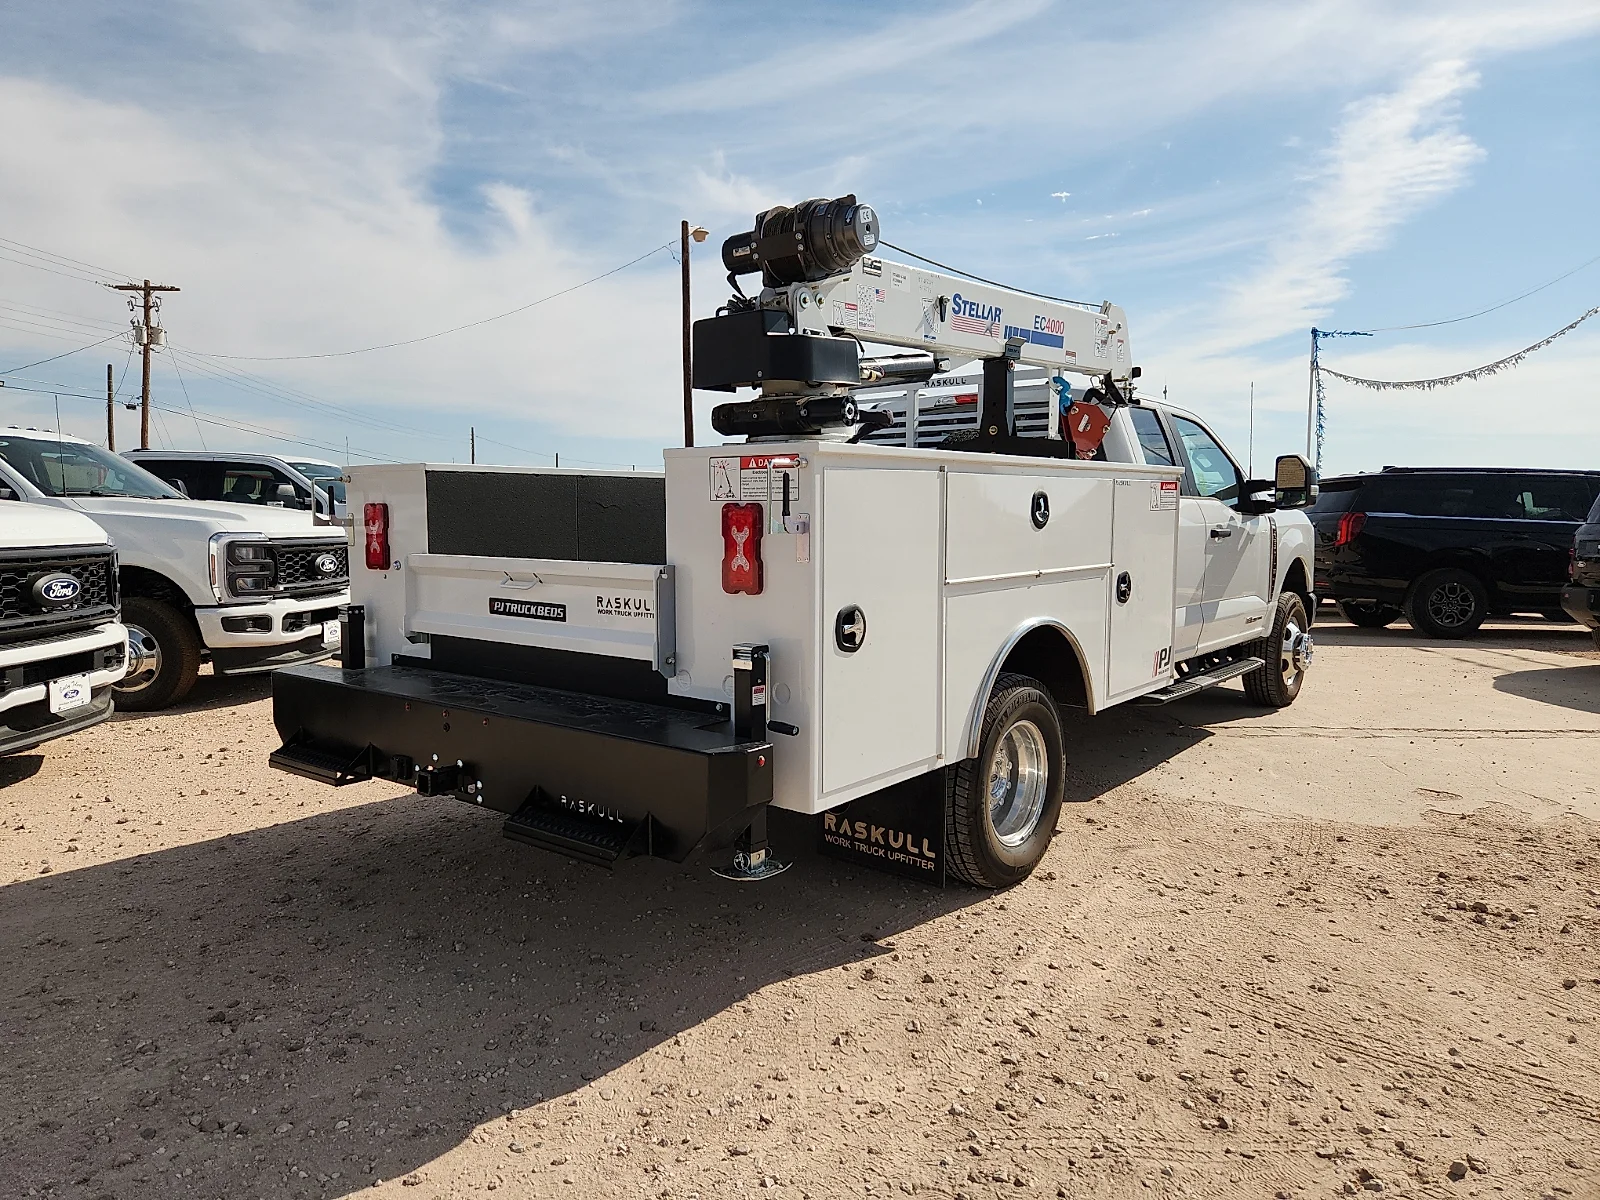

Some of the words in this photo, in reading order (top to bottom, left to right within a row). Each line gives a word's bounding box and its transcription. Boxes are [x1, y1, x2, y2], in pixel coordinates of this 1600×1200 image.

[952, 293, 1002, 323] STELLAR
[1034, 314, 1065, 335] EC4000
[48, 581, 75, 598] Ford
[494, 601, 504, 612] PJ
[561, 795, 623, 823] RASKULL
[824, 813, 936, 858] RASKULL
[824, 833, 851, 849] WORK
[854, 841, 885, 858] TRUCK
[888, 850, 935, 871] UPFITTER
